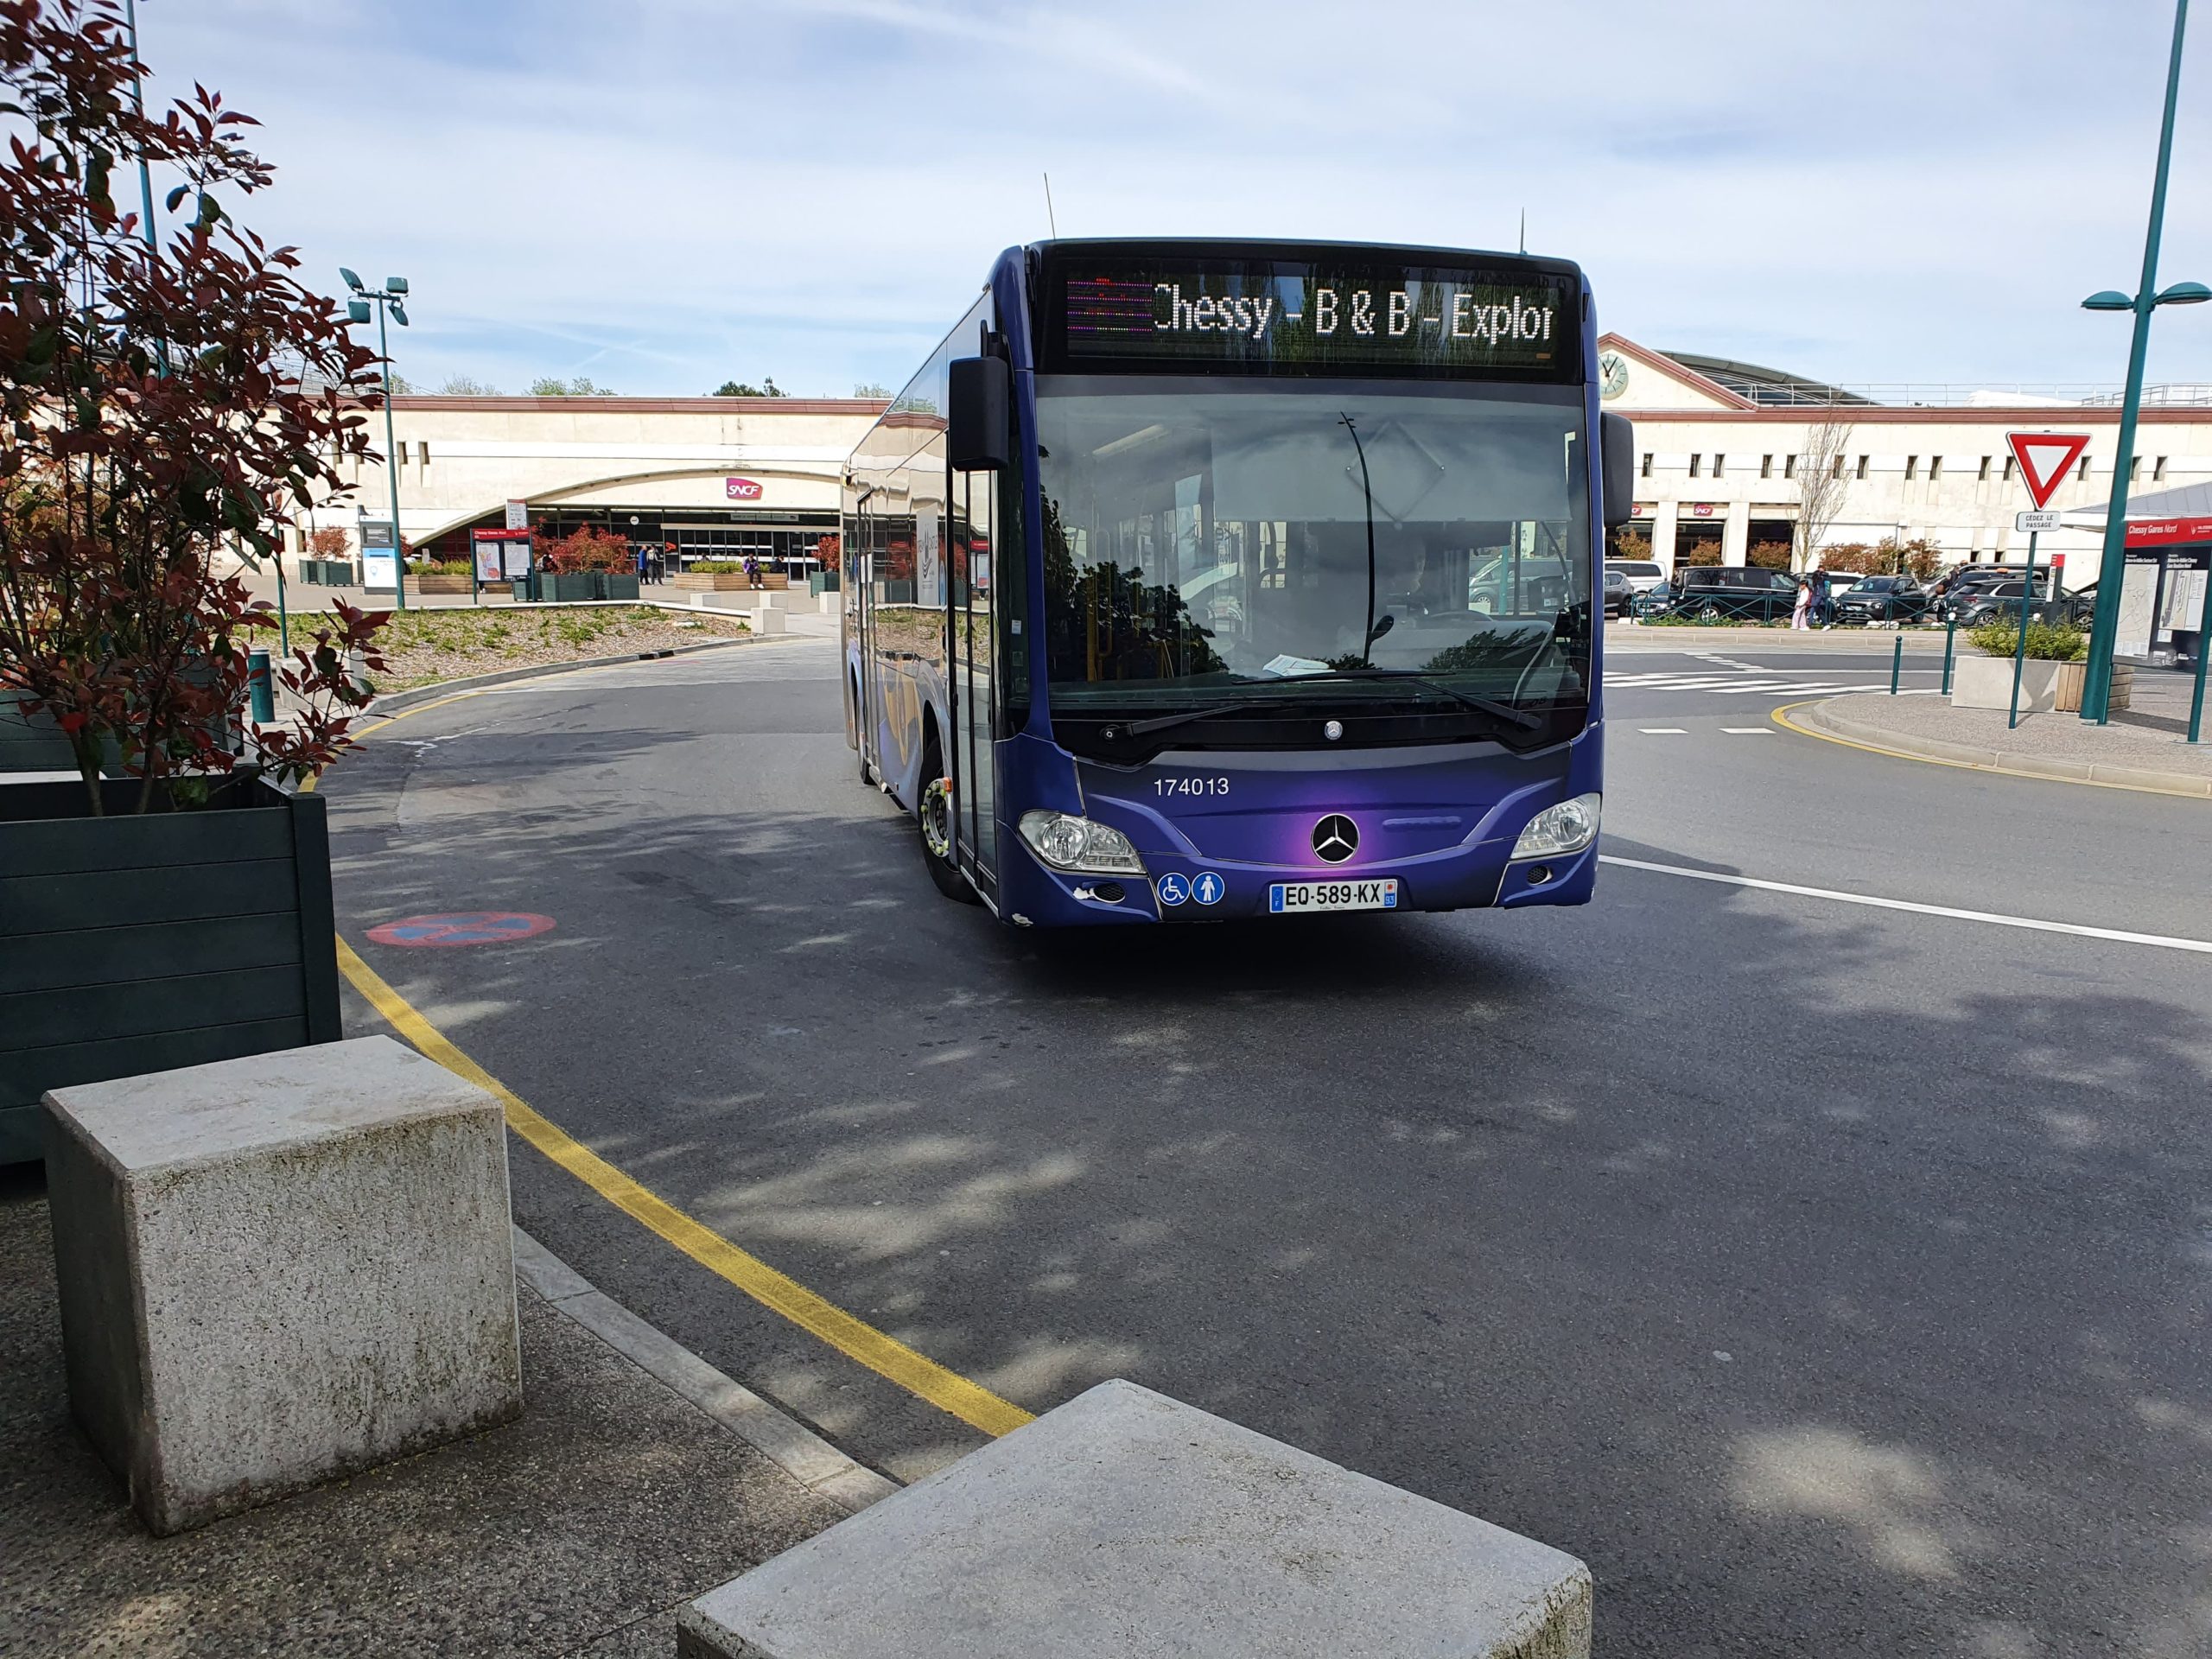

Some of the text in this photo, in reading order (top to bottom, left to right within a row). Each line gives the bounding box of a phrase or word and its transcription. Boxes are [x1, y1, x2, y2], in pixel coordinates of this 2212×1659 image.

[1316, 288, 1339, 334] B
[1351, 289, 1376, 335] &
[1389, 290, 1411, 336] B
[728, 485, 760, 496] SNCF
[2128, 524, 2178, 536] Chessy Gares Nord
[1154, 777, 1230, 797] 174013
[1286, 883, 1381, 906] EQ-589-KX
[1385, 895, 1395, 905] 93
